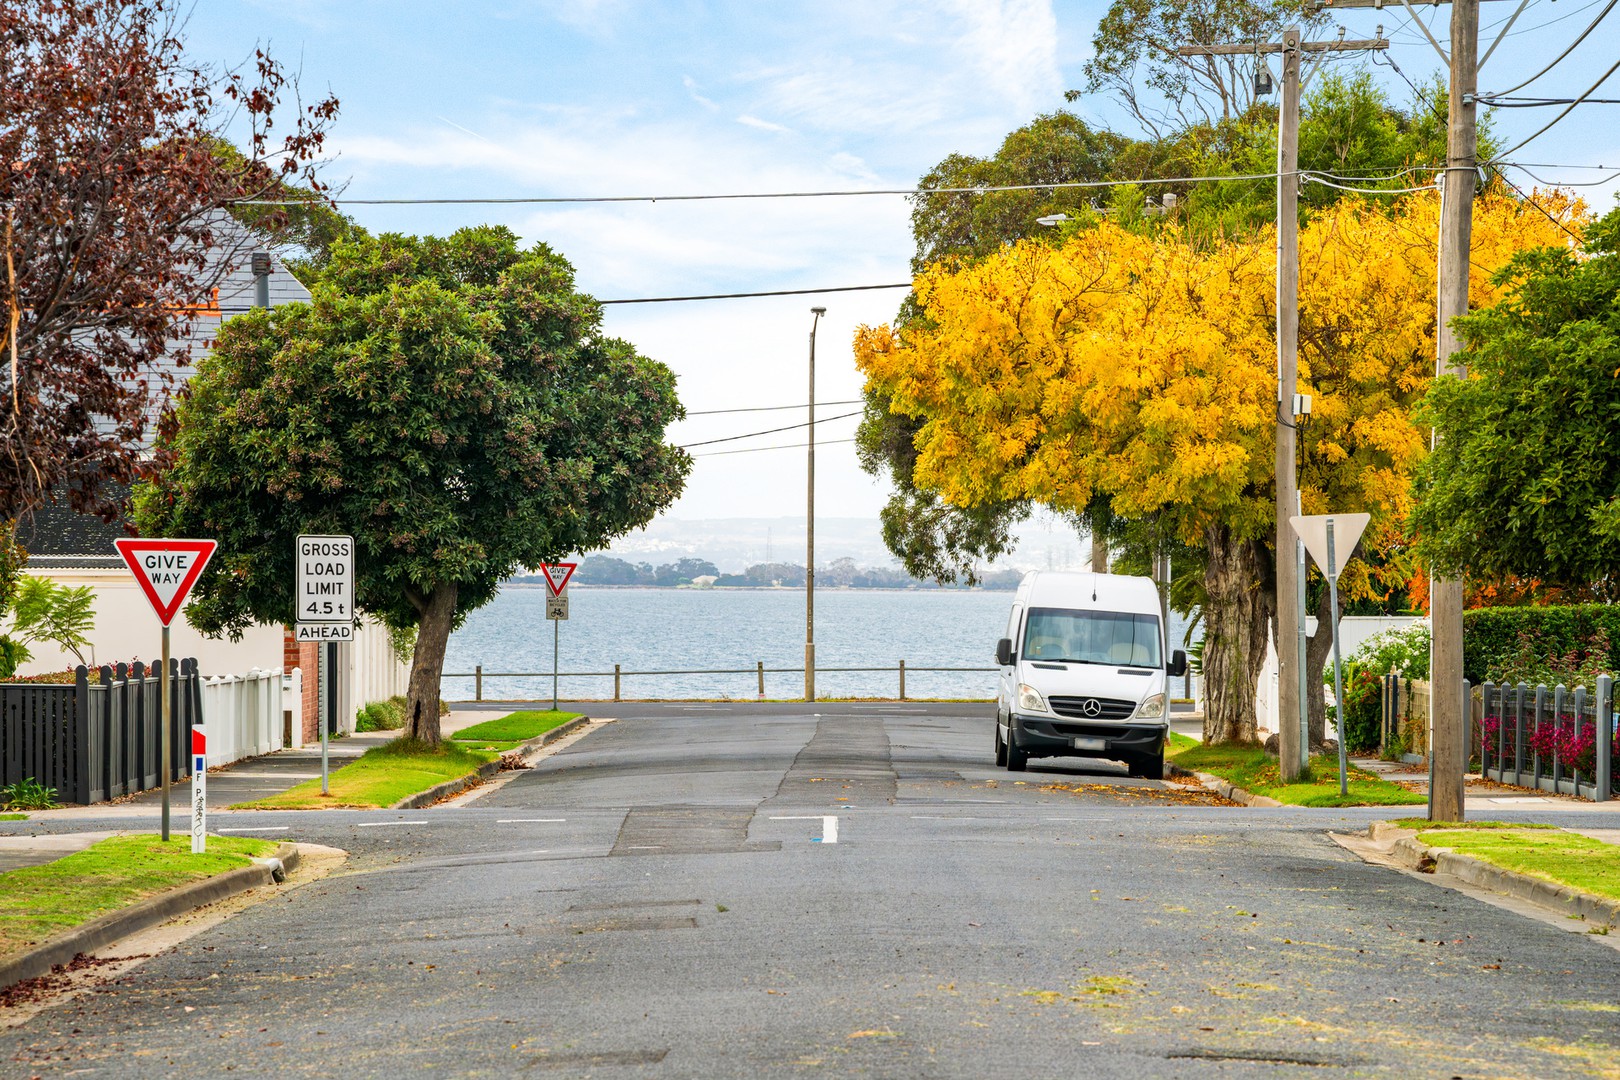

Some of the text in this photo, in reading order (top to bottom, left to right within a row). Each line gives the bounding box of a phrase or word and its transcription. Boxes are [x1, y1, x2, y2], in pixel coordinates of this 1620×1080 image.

[301, 543, 349, 556] GROSS
[145, 555, 188, 569] GIVE
[306, 562, 345, 576] LOAD
[151, 572, 181, 584] WAY
[306, 582, 344, 595] LIMIT
[306, 601, 345, 614] 4.5 t
[299, 627, 351, 638] AHEAD
